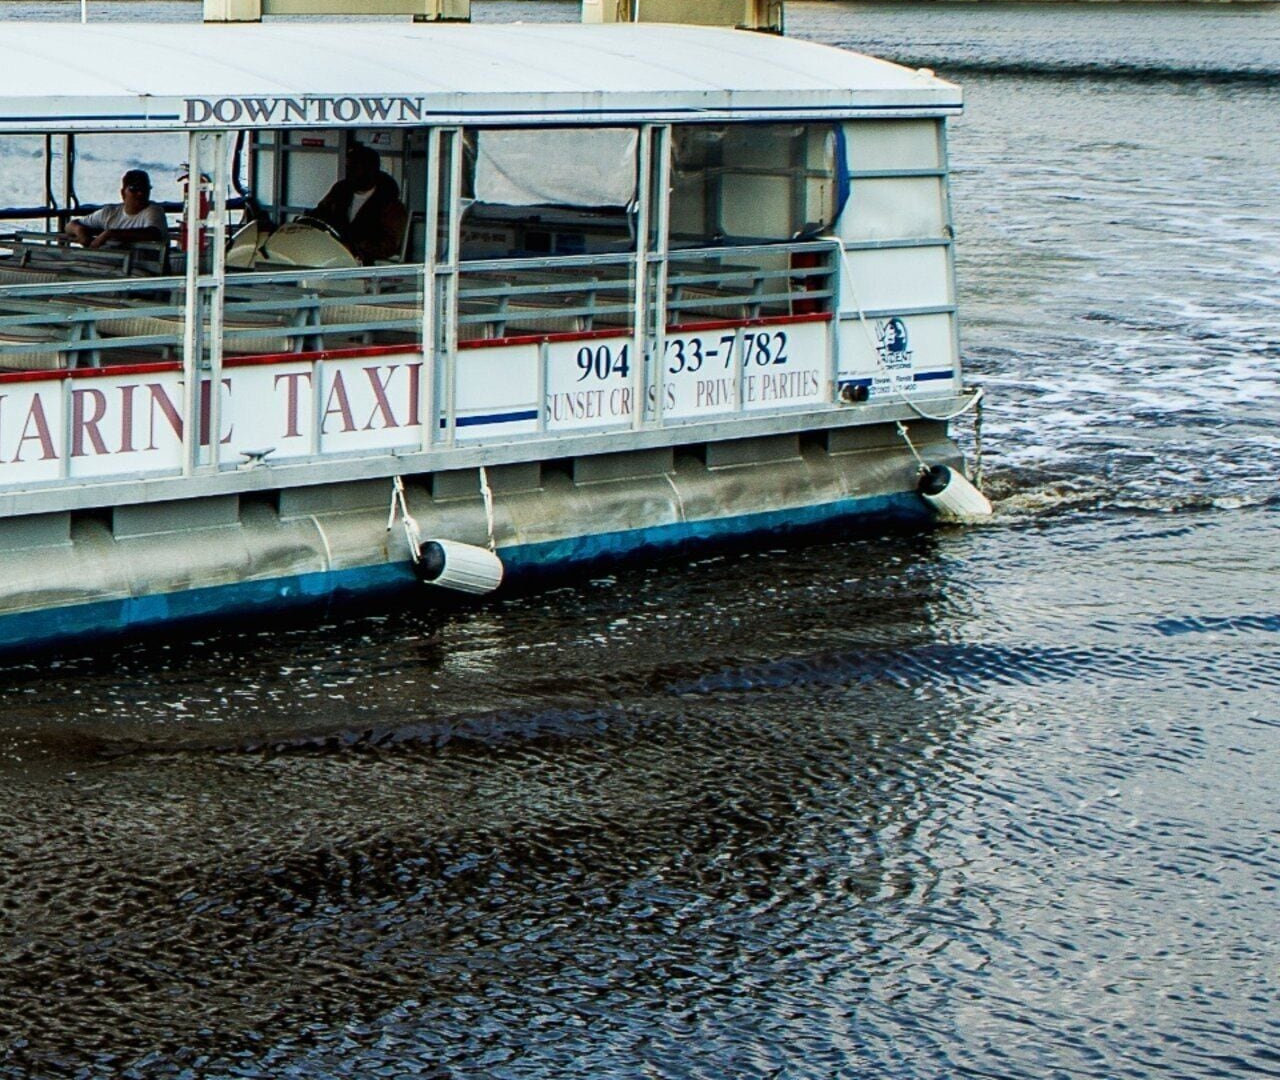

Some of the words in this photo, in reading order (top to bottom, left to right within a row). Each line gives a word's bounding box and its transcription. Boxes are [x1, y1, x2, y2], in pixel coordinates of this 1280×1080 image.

[183, 97, 425, 124] DOWNTOWN
[274, 362, 424, 438] TAXI
[762, 369, 820, 402] PARTIES
